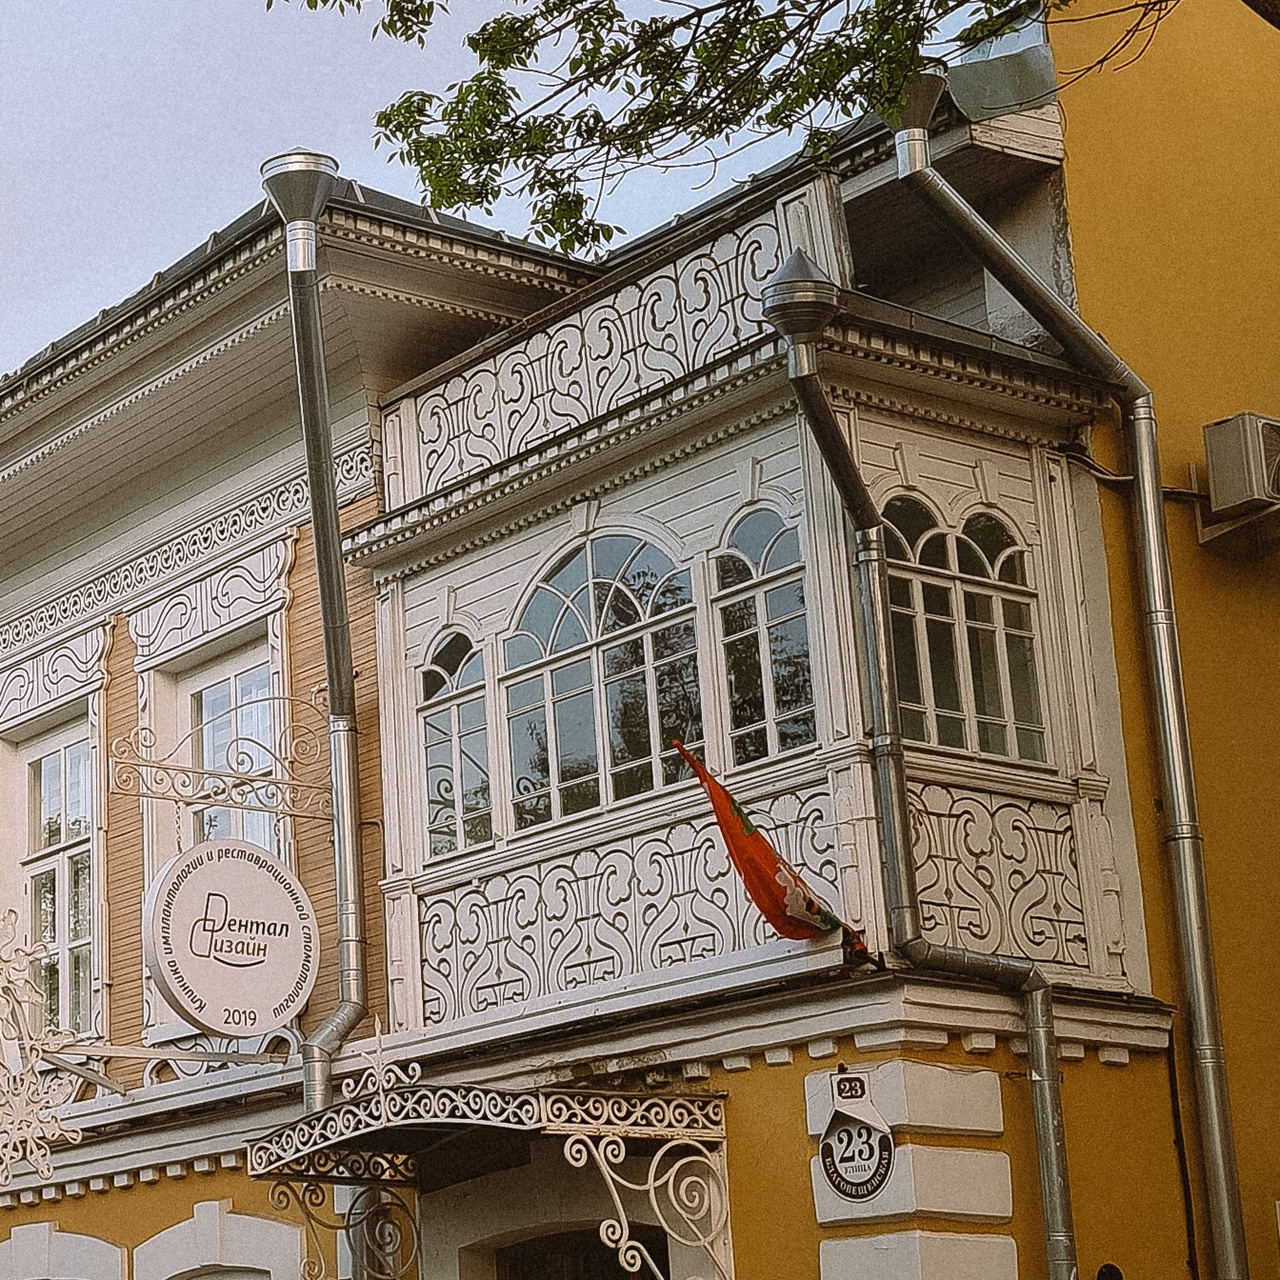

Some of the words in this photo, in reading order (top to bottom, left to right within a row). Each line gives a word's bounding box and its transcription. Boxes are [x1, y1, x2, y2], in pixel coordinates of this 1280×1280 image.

[207, 851, 215, 863] и
[217, 847, 311, 922] реставрационной
[160, 854, 205, 956] имплантологии
[167, 959, 208, 1014] Клиника
[272, 925, 314, 1019] стоматологии
[223, 1008, 258, 1027] 2019
[840, 1080, 862, 1097] 23
[836, 1125, 876, 1165] 23
[843, 1164, 873, 1175] УЛИЦА
